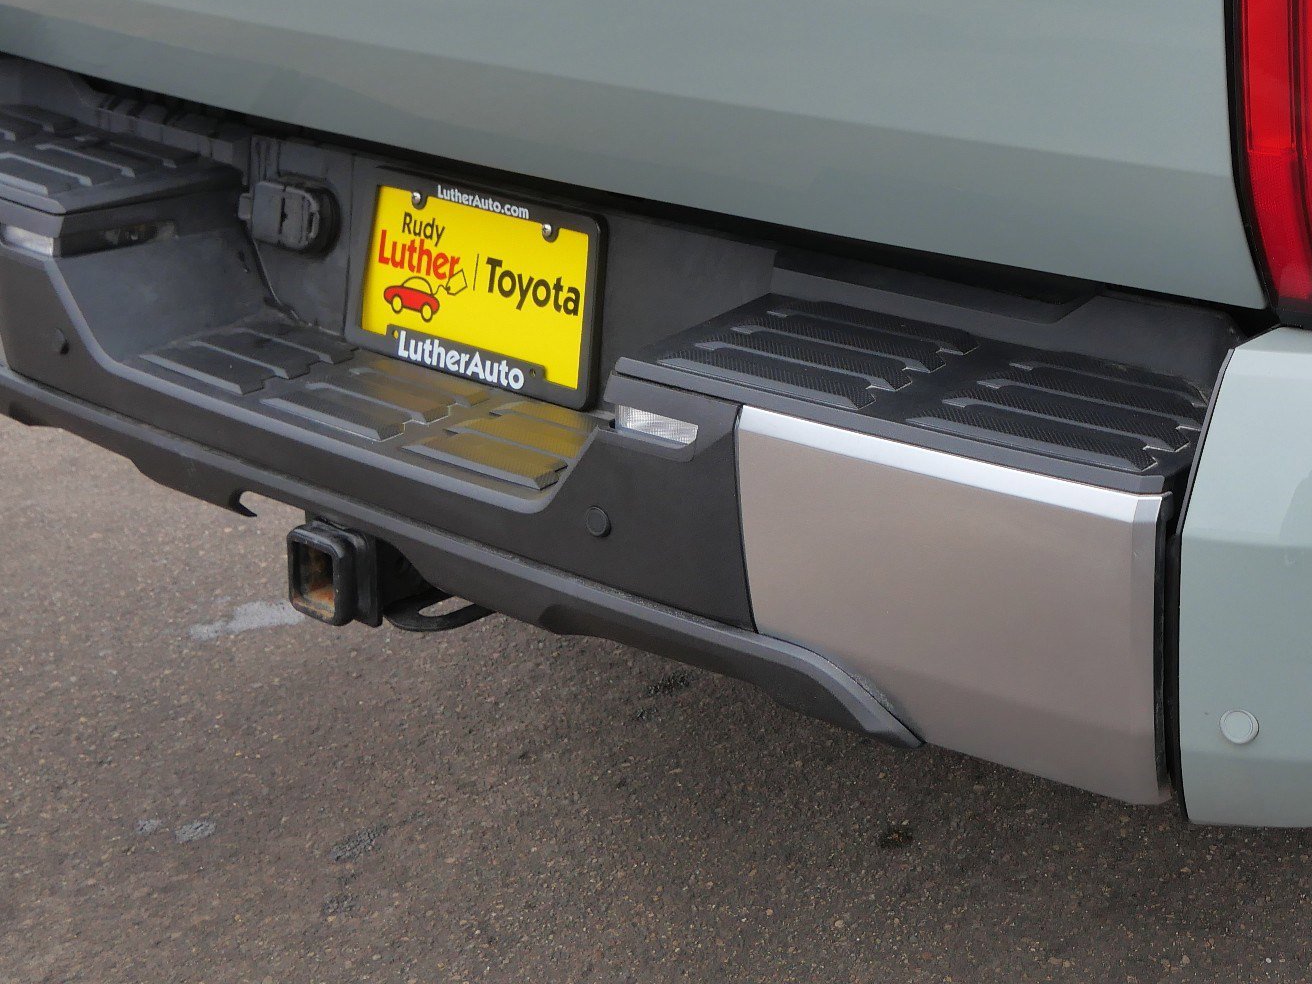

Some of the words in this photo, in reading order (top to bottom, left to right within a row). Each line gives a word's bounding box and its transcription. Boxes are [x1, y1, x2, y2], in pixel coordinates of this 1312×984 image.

[437, 184, 529, 219] LutherAuto.com
[402, 212, 445, 247] Rudy
[378, 229, 460, 280] Luther
[486, 257, 580, 316] Toyota
[398, 330, 525, 390] LutherAuto
